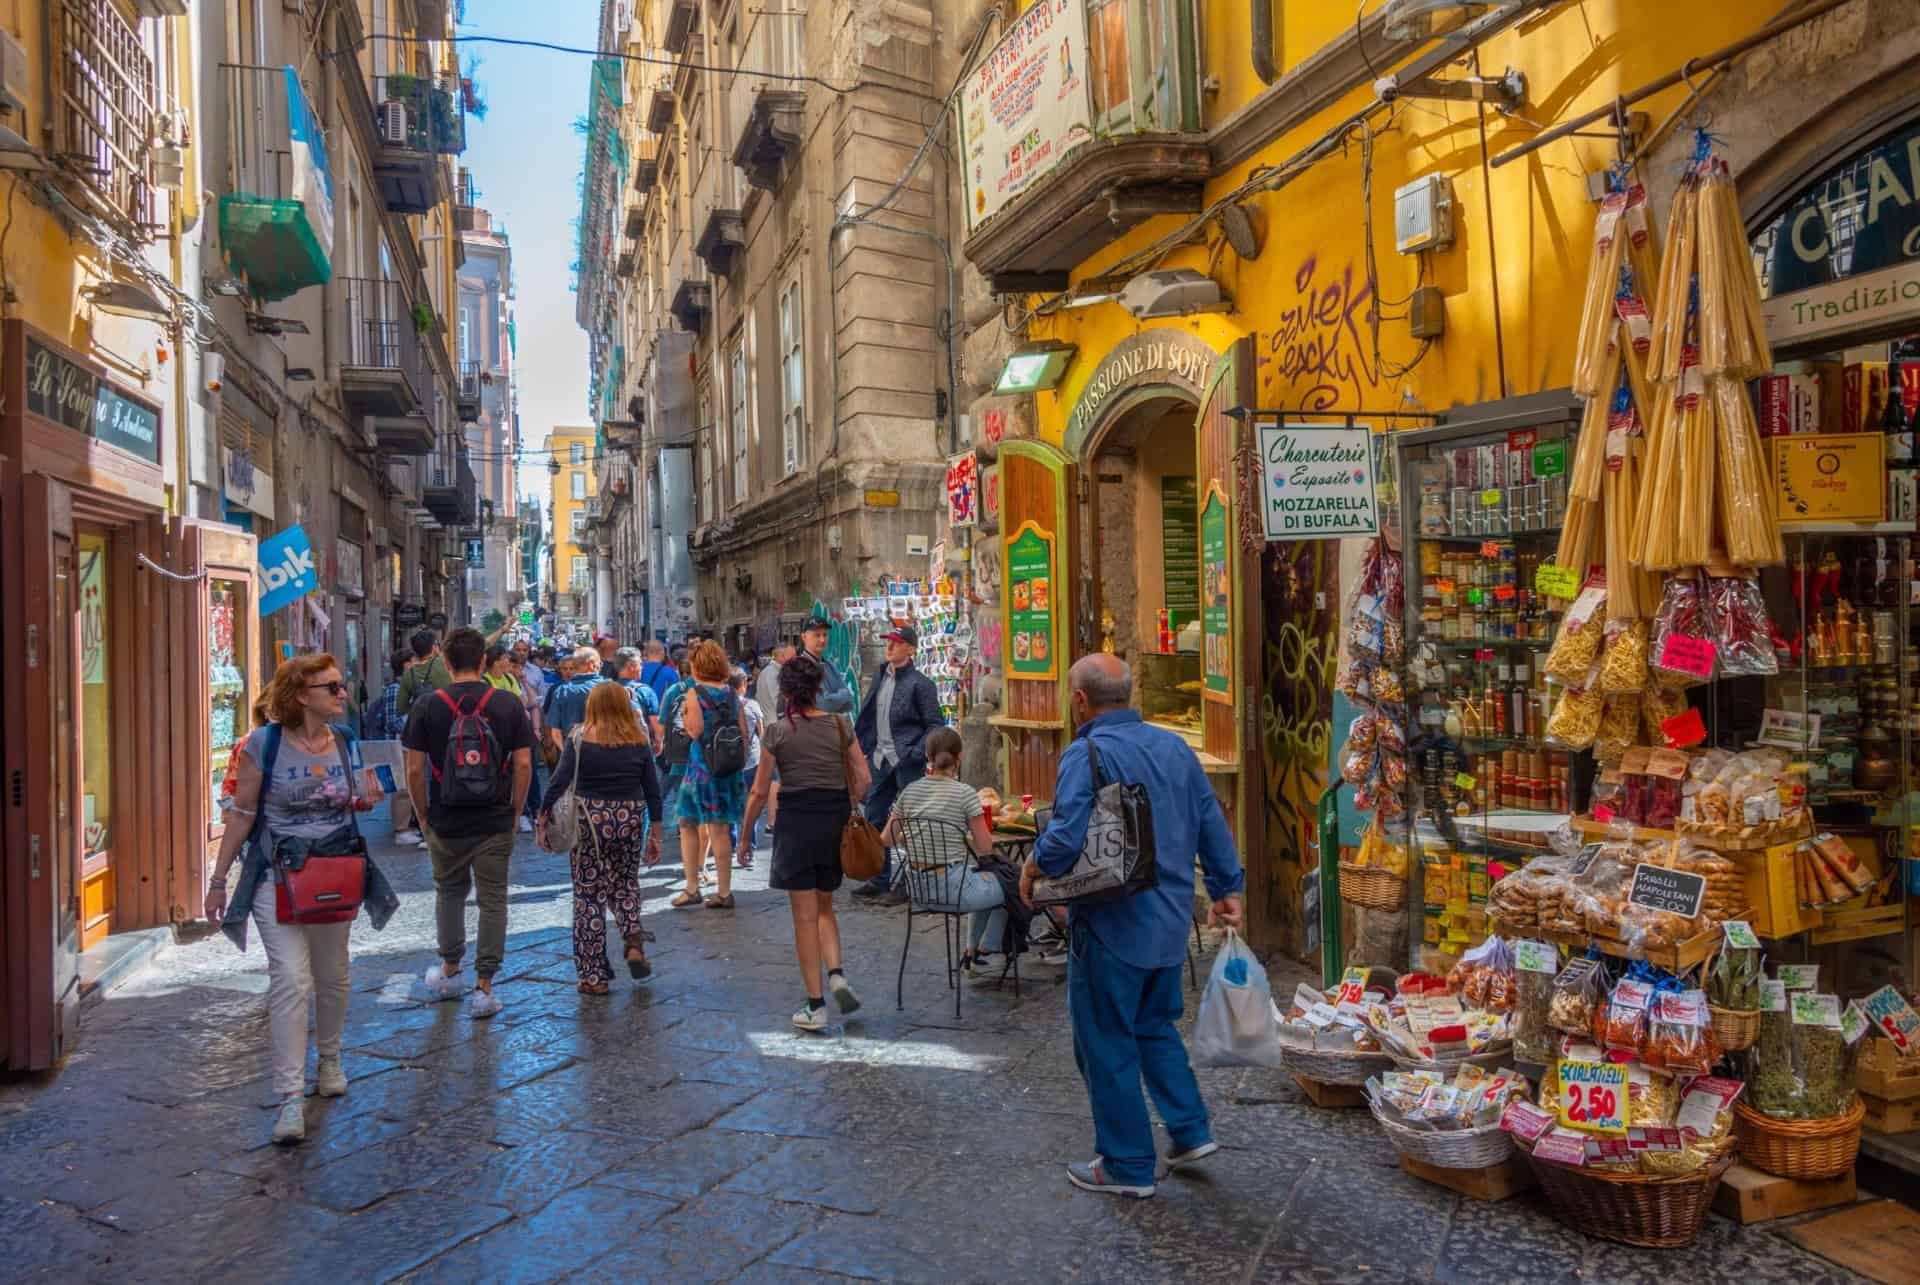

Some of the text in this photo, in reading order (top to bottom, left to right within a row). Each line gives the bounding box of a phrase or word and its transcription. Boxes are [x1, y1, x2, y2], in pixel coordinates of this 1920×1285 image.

[1076, 347, 1144, 429] PASSIONE
[1147, 343, 1164, 369] DI
[1289, 464, 1351, 491] Esposito
[1272, 496, 1369, 512] MOZZARELLA
[1284, 514, 1360, 529] DI BUFALA
